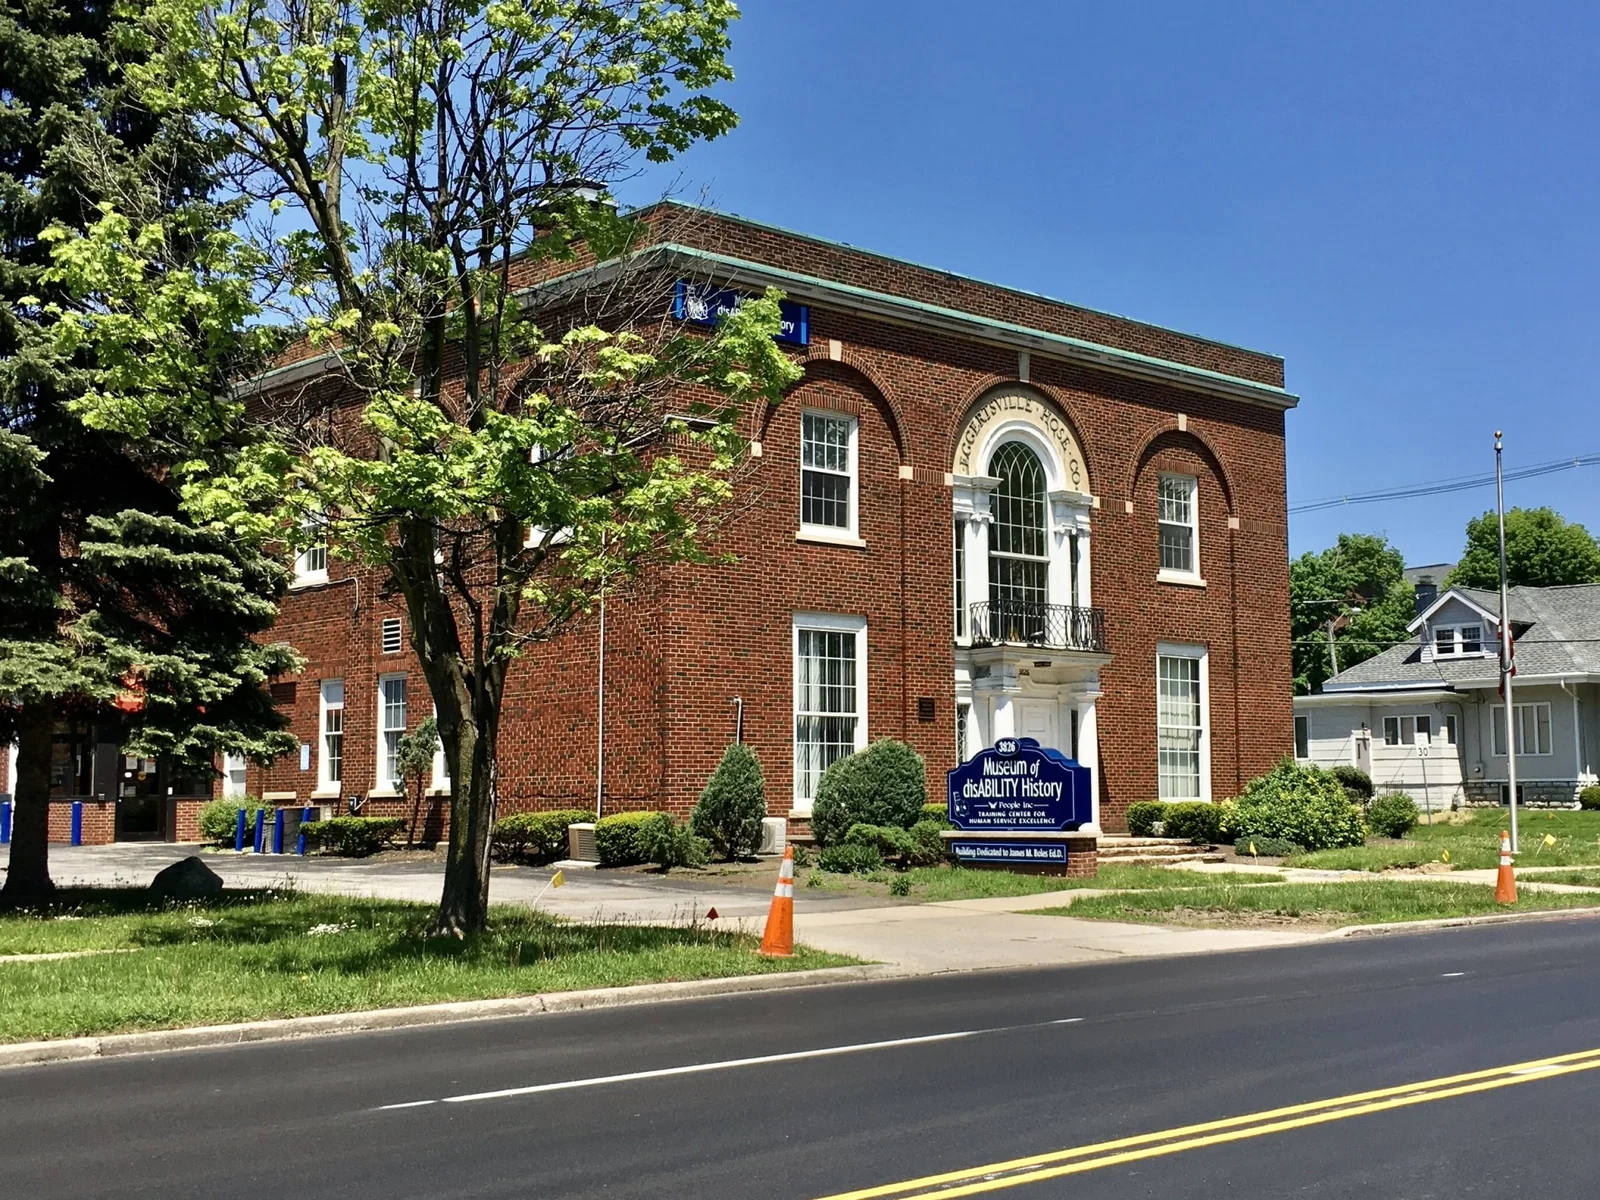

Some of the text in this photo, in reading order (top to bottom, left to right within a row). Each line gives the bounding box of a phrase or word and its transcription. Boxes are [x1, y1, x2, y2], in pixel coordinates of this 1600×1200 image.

[959, 394, 1033, 475] EGGERTSVILLE
[1040, 406, 1071, 451] HOSE
[998, 741, 1016, 753] 3826
[1418, 747, 1429, 757] 30
[983, 757, 1041, 778] Museum of
[963, 777, 1063, 802] disABILITY History
[999, 801, 1034, 810] People Inc
[955, 846, 976, 858] Building
[976, 847, 1002, 857] Dedicated
[1002, 848, 1009, 857] to
[1009, 848, 1025, 857] James
[1033, 848, 1049, 858] Boles
[1049, 848, 1064, 858] Ed.D.
